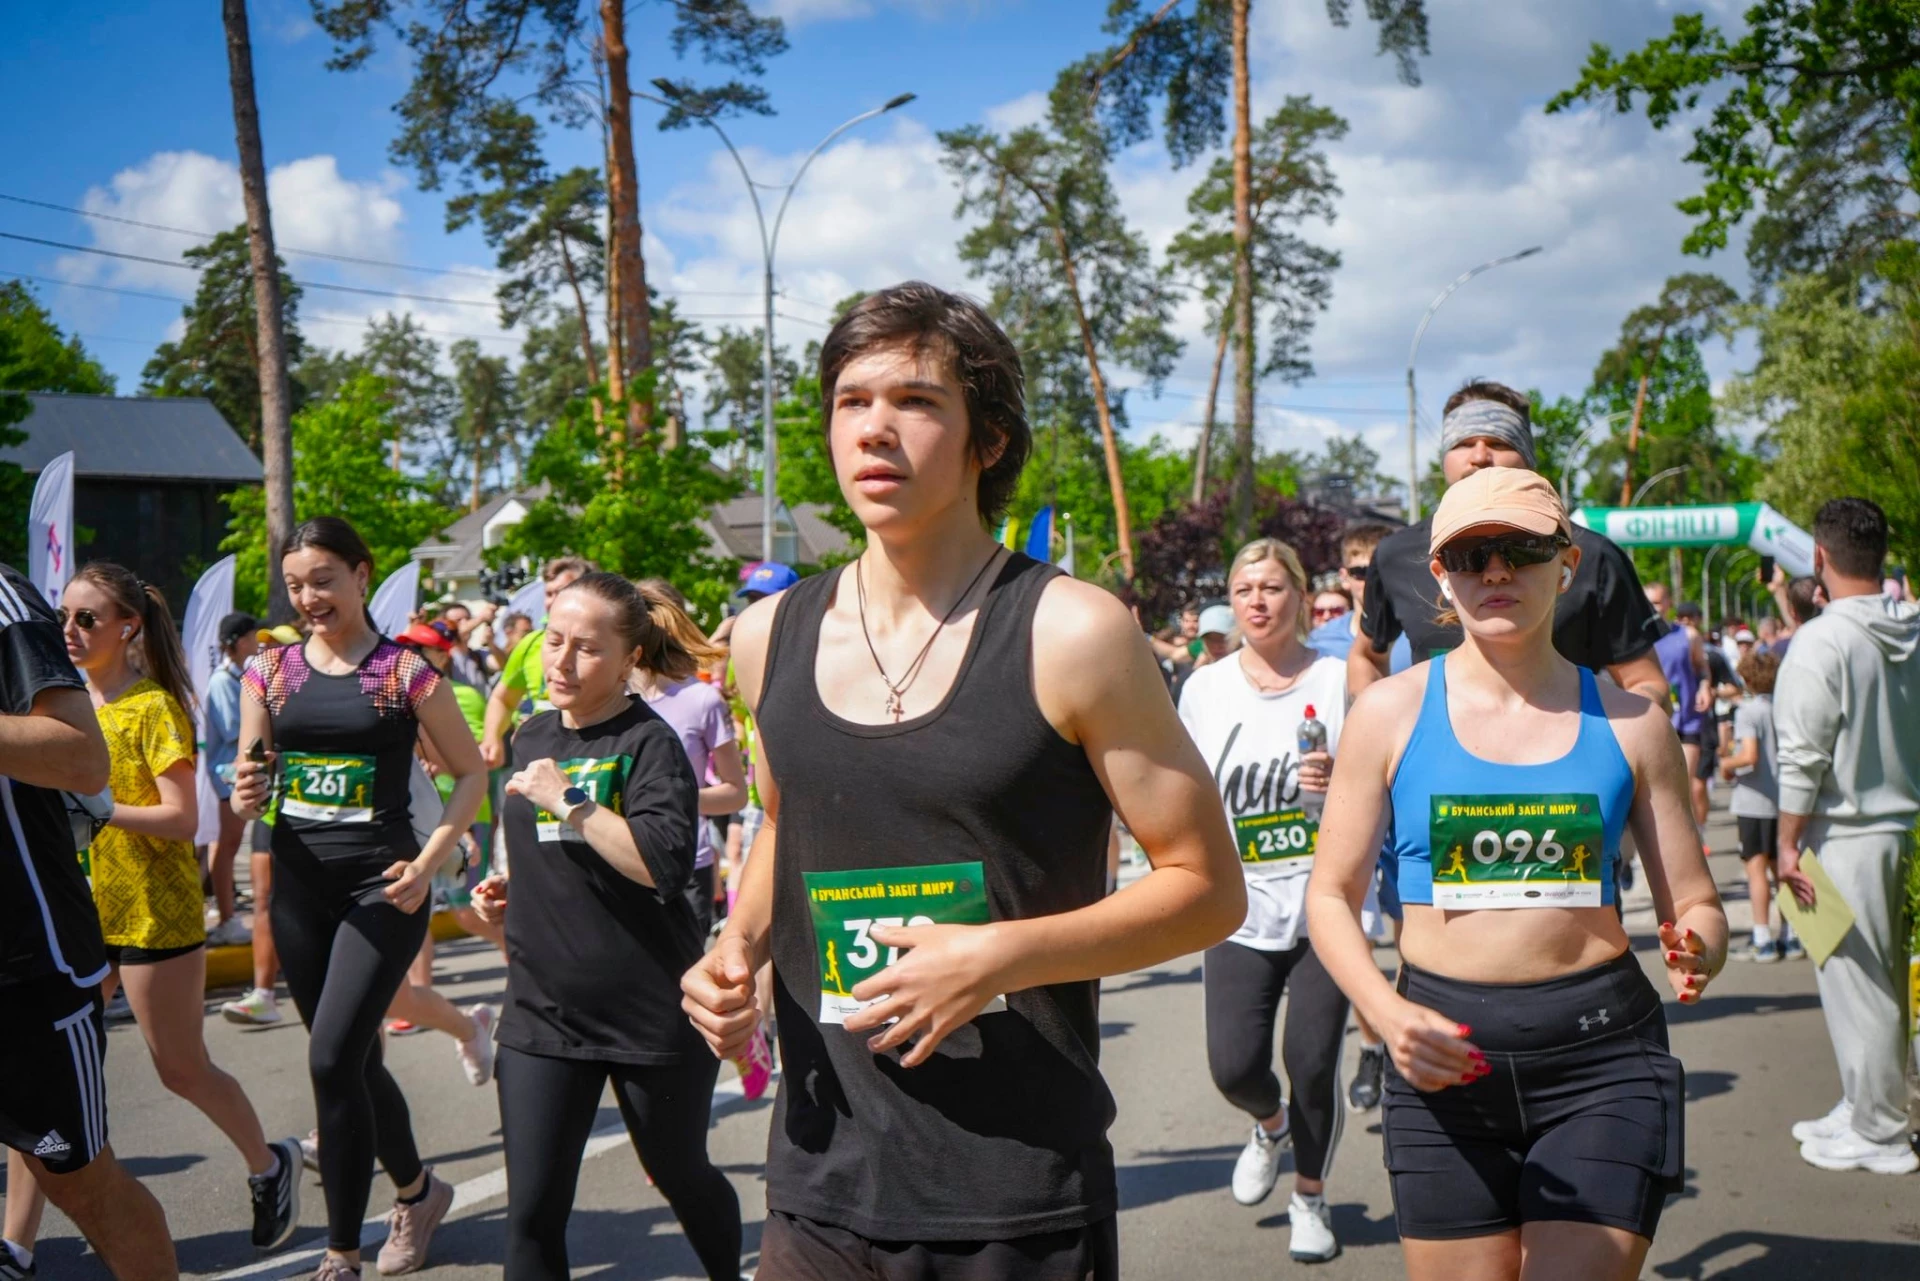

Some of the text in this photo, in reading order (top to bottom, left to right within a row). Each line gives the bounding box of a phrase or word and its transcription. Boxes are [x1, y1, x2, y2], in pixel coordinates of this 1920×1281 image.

[1626, 512, 1720, 537] ФІНІШ
[1214, 722, 1300, 815] hyp
[304, 771, 347, 797] 261
[1451, 803, 1577, 817] БУЧАНСЬКИЙ ЗАБІГ МИРУ
[1257, 825, 1307, 853] 230
[1472, 829, 1565, 865] 096
[818, 881, 955, 902] БУЧАНСЬКИЙ ЗАБІГ МИРУ
[843, 915, 936, 969] 37
[34, 1143, 71, 1155] adidas
